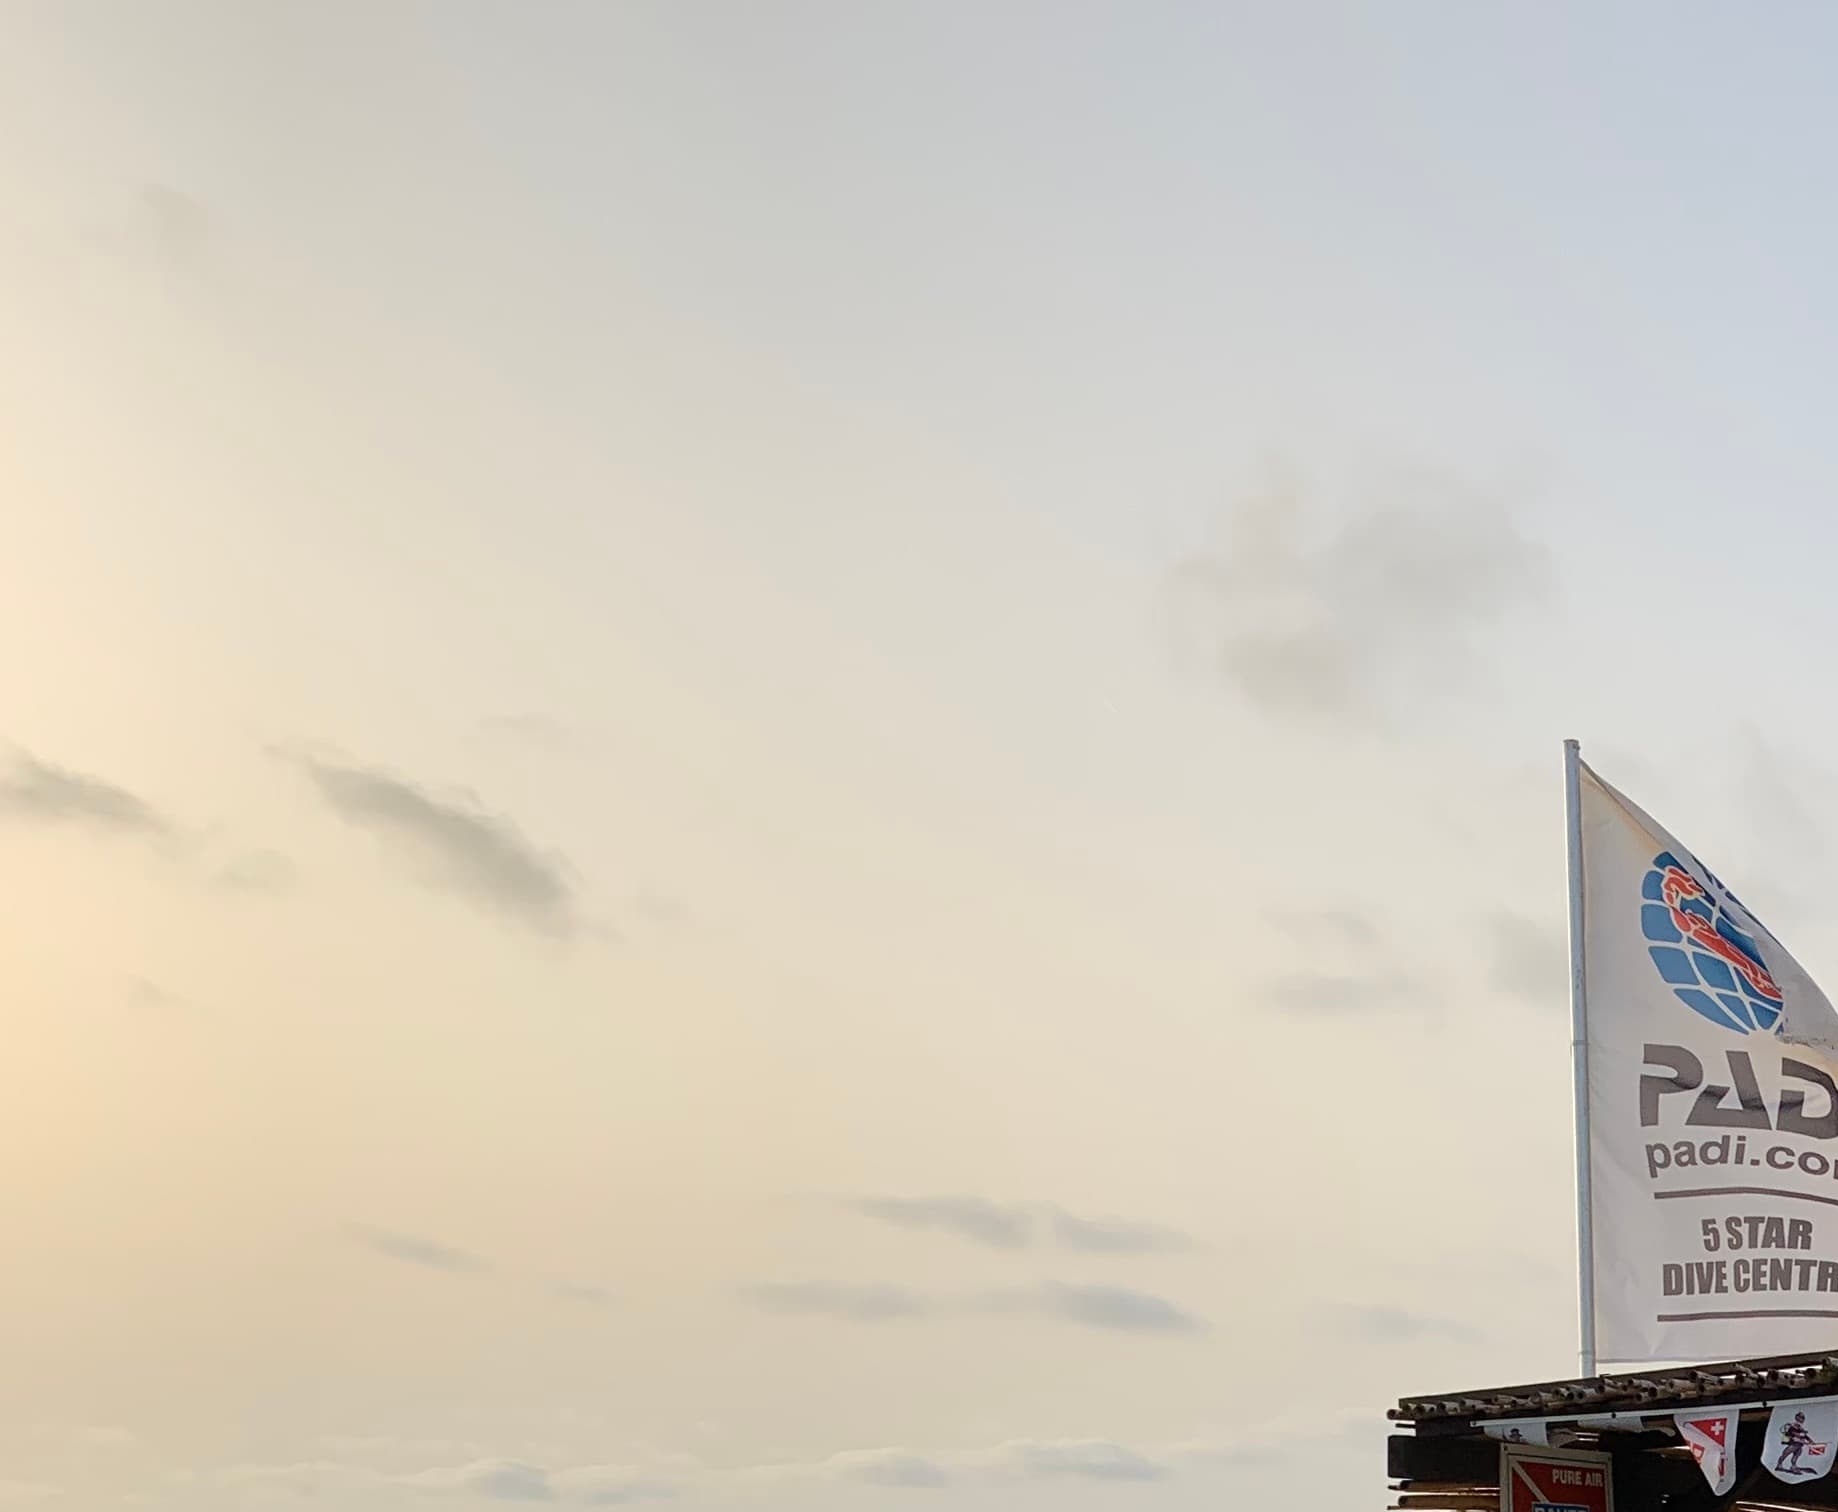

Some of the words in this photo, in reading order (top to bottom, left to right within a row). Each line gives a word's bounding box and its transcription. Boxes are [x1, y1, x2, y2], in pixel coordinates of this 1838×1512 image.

[1701, 1218, 1721, 1252] 5
[1725, 1216, 1813, 1250] STAR
[1663, 1260, 1728, 1296] DIVE
[1552, 1469, 1582, 1486] PURE
[1585, 1473, 1603, 1488] AIR
